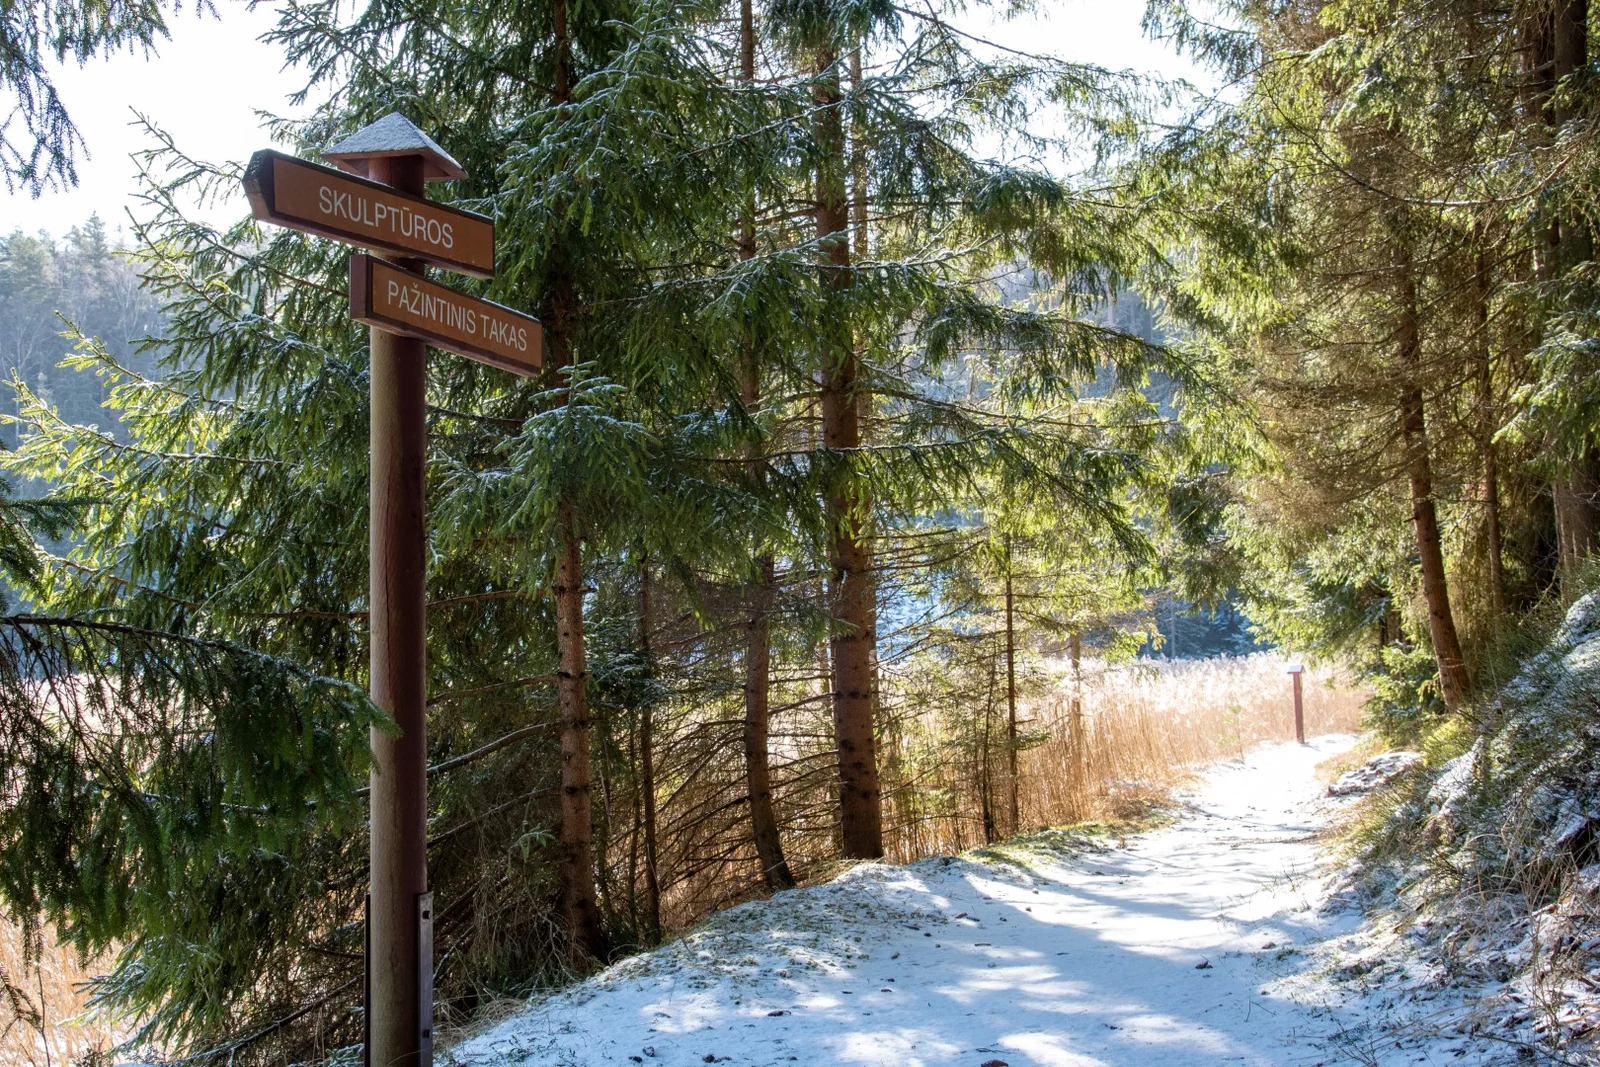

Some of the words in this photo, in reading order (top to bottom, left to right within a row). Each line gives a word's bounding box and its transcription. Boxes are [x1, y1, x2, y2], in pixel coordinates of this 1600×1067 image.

[318, 186, 454, 249] SKULPTŪROS
[387, 280, 476, 334] PAŽINTINIS
[480, 315, 528, 352] TAKAS
